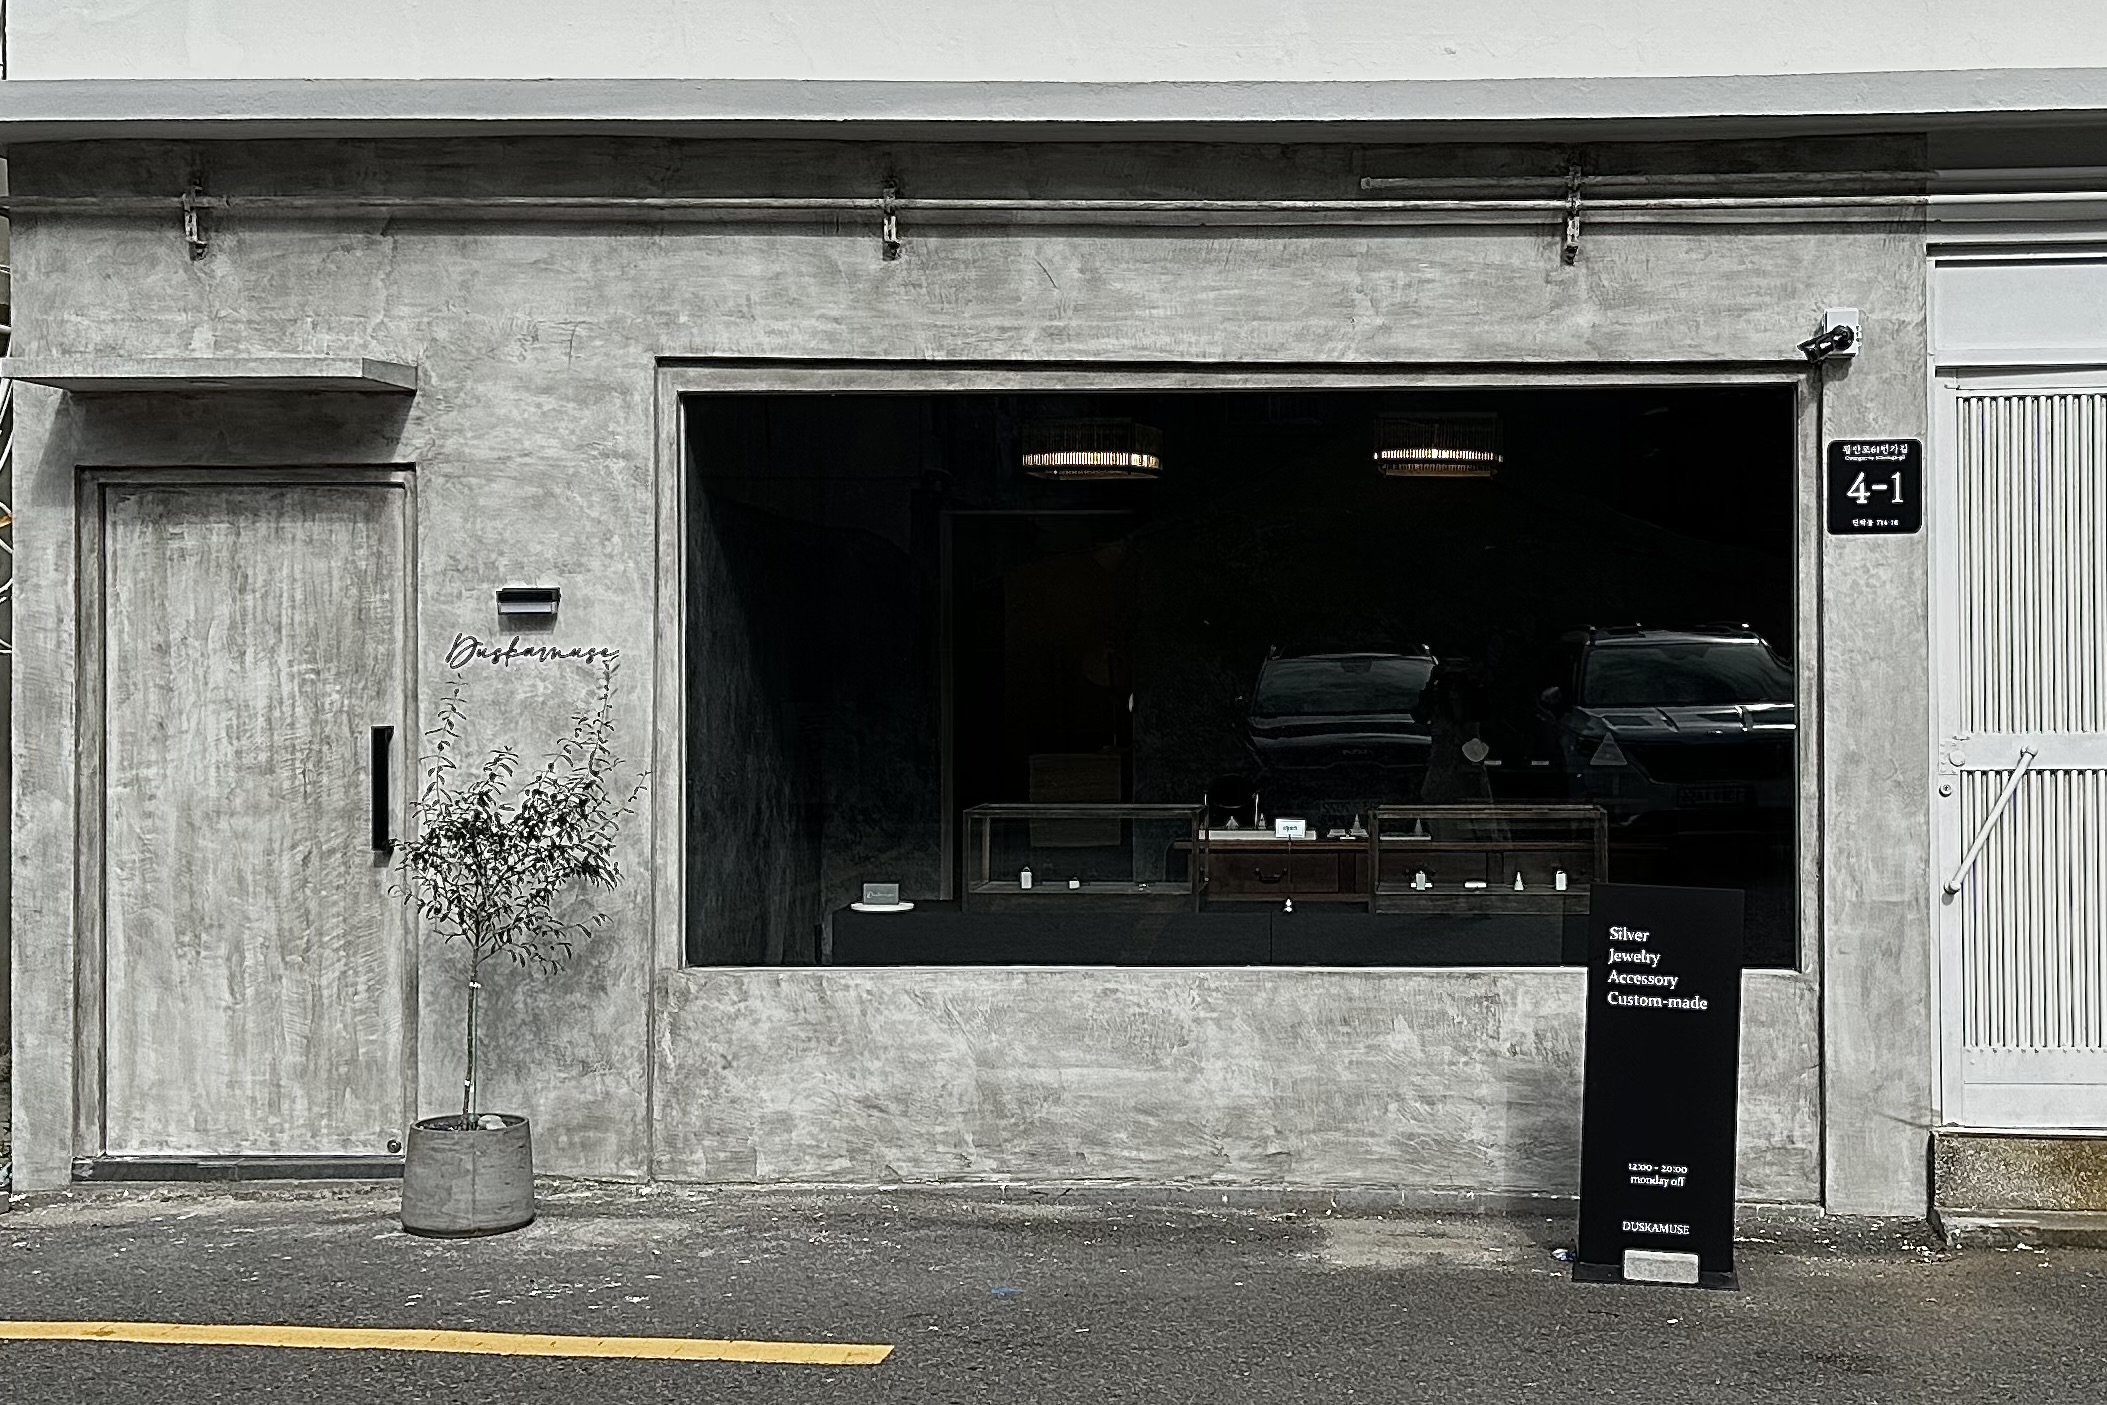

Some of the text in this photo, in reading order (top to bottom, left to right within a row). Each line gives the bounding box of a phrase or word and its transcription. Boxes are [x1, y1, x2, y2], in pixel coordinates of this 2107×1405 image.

[1846, 471, 1904, 504] 4-1
[1609, 926, 1650, 942] Silver
[1607, 948, 1661, 968] Jewelry
[1607, 969, 1679, 990] Accessory
[1607, 991, 1708, 1010] Custom-made
[1630, 1174, 1686, 1188] monday off
[1622, 1220, 1690, 1235] DUSKAMUSE
